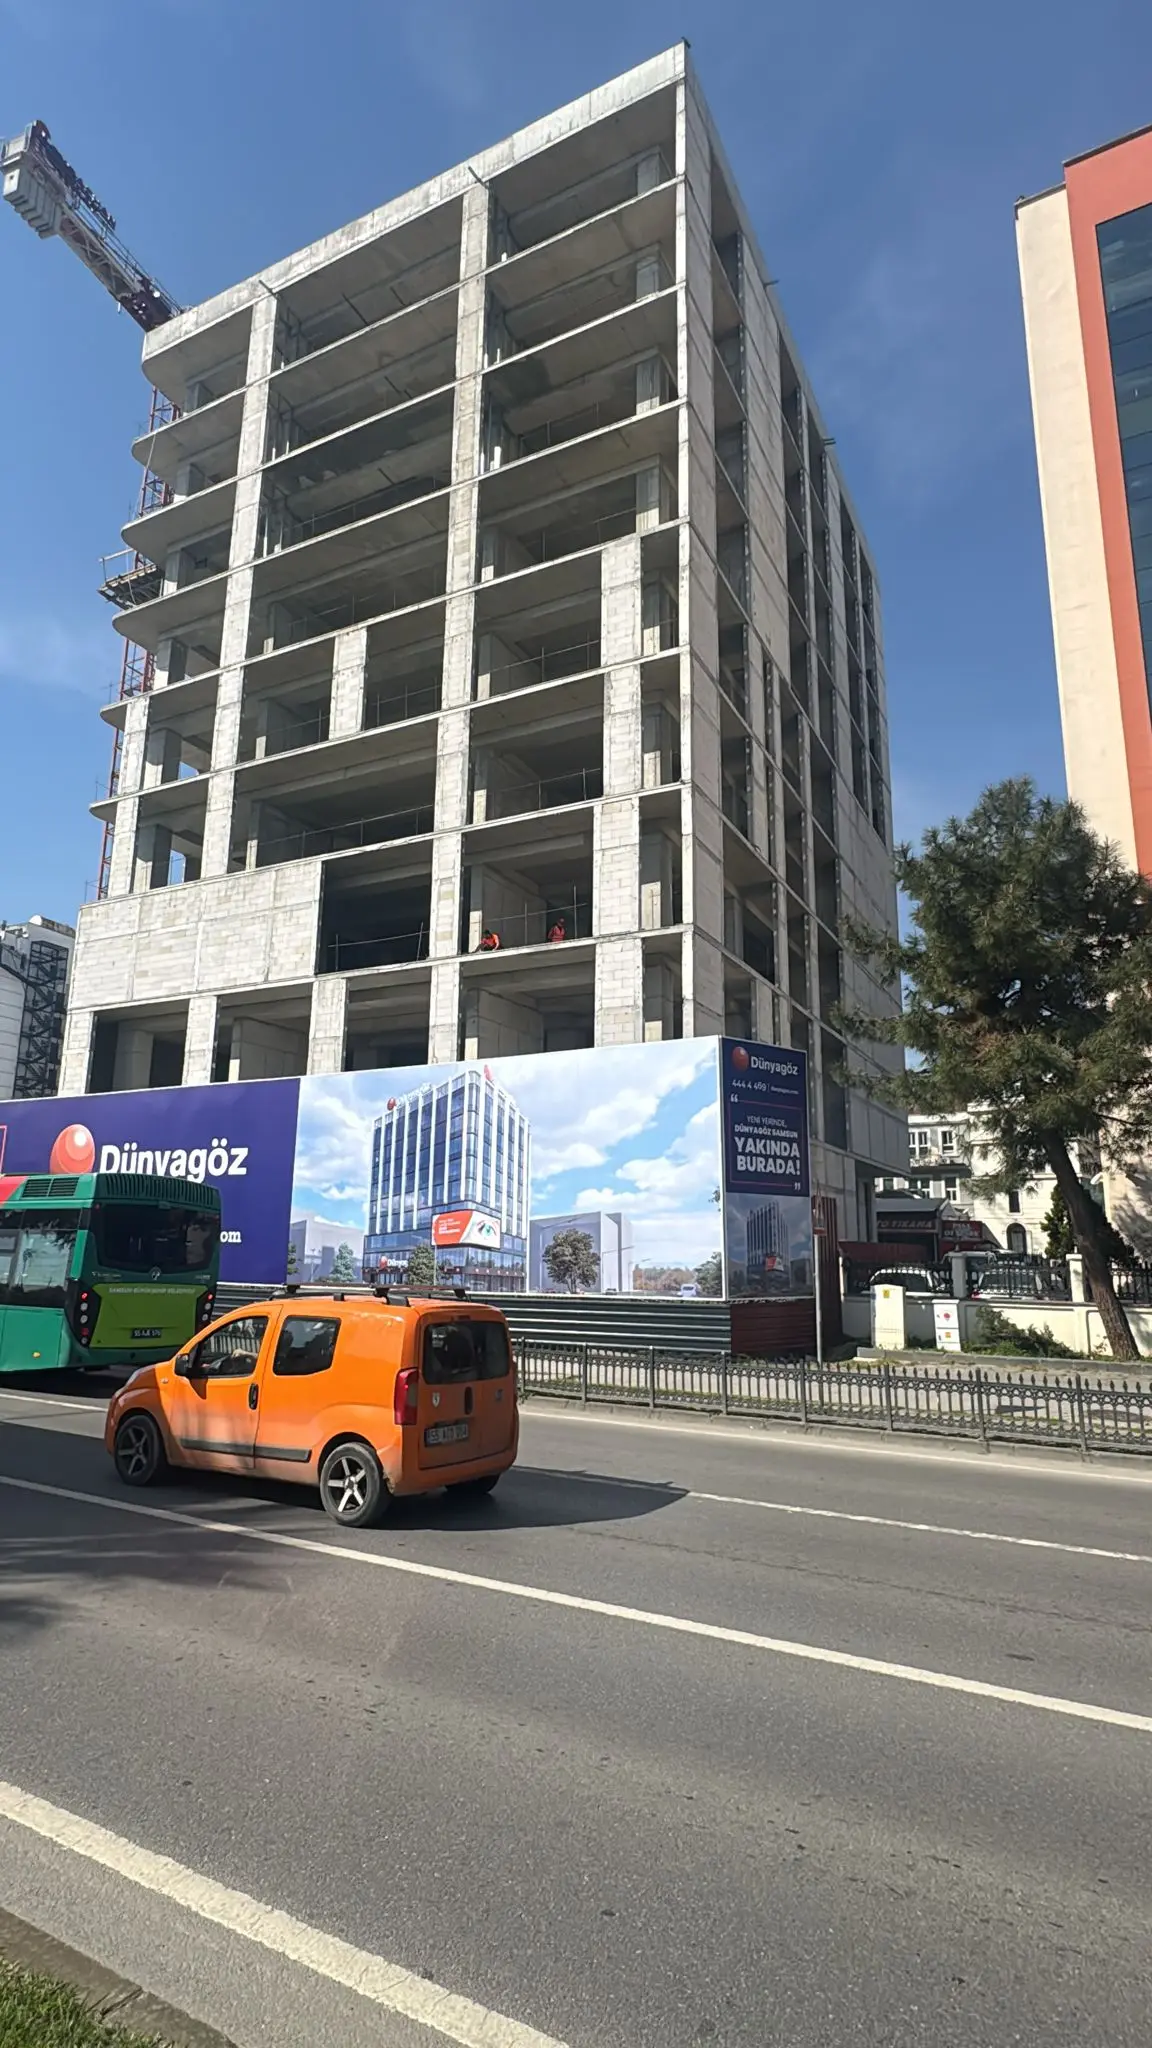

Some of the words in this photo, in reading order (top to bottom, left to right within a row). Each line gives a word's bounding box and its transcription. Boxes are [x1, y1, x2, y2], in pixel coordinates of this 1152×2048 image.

[751, 1055, 799, 1076] Dünyagöz
[734, 1136, 800, 1158] YAKINDA
[736, 1155, 800, 1175] BURADA!
